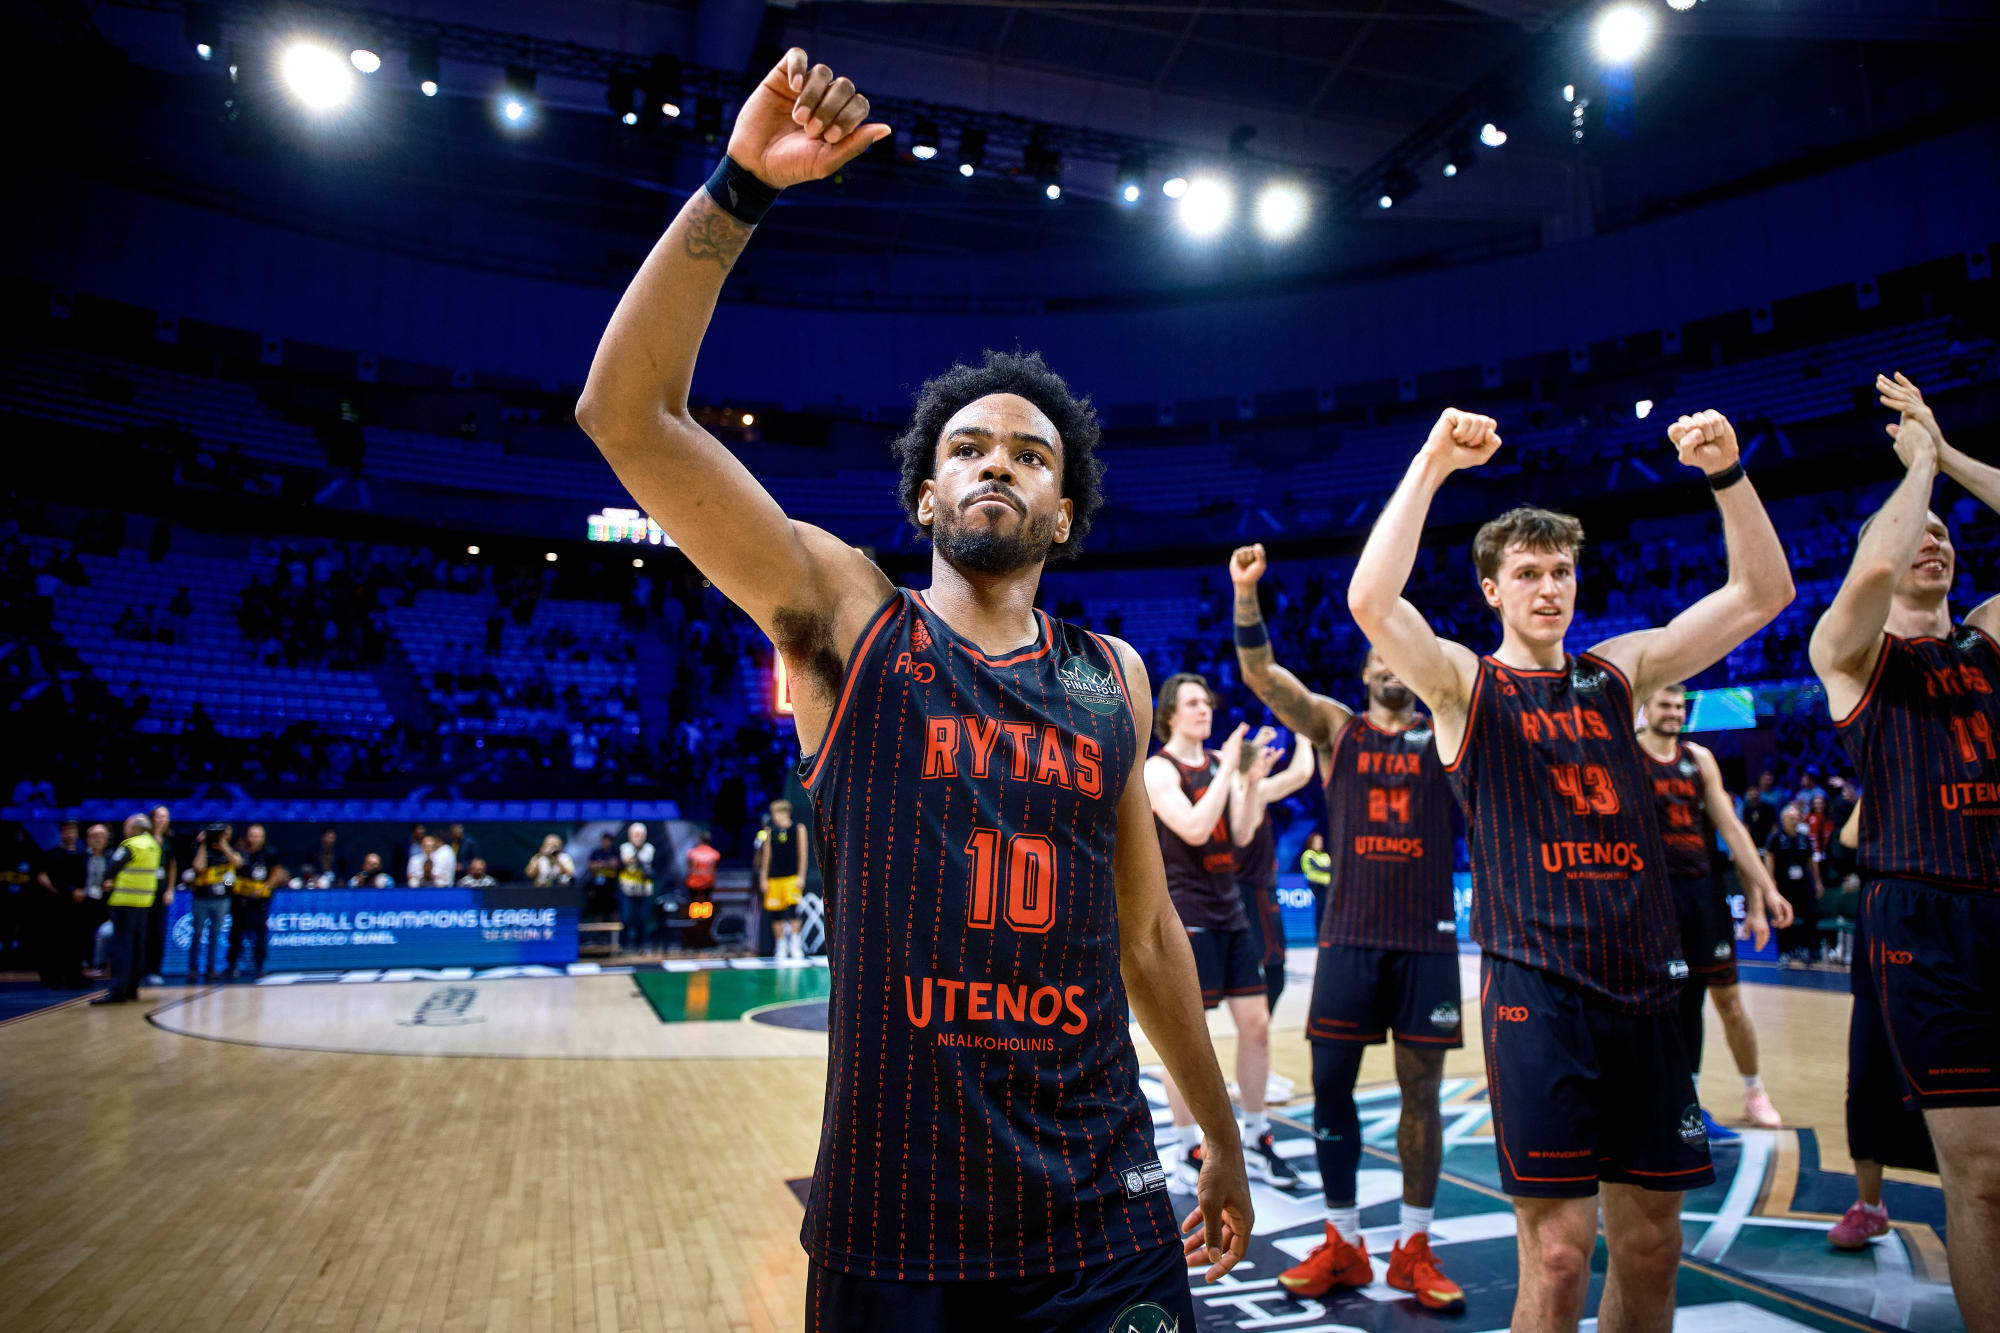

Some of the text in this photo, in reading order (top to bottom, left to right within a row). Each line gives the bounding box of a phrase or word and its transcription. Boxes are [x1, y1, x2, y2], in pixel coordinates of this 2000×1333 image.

[1064, 680, 1097, 693] FINAL
[1096, 684, 1122, 696] FOUR
[1520, 705, 1612, 744] RYTAS
[921, 714, 1103, 800] RYTAS
[1356, 752, 1421, 776] RYTAS
[1549, 763, 1620, 815] 43
[1940, 783, 2000, 811] UTEN
[1355, 835, 1424, 859] UTENOS
[1541, 841, 1644, 873] UTENOS
[964, 827, 1057, 934] 10
[479, 908, 557, 928] LEAGUE
[904, 975, 1088, 1036] UTENOS
[937, 1032, 1054, 1053] NEALKOHOLINIS
